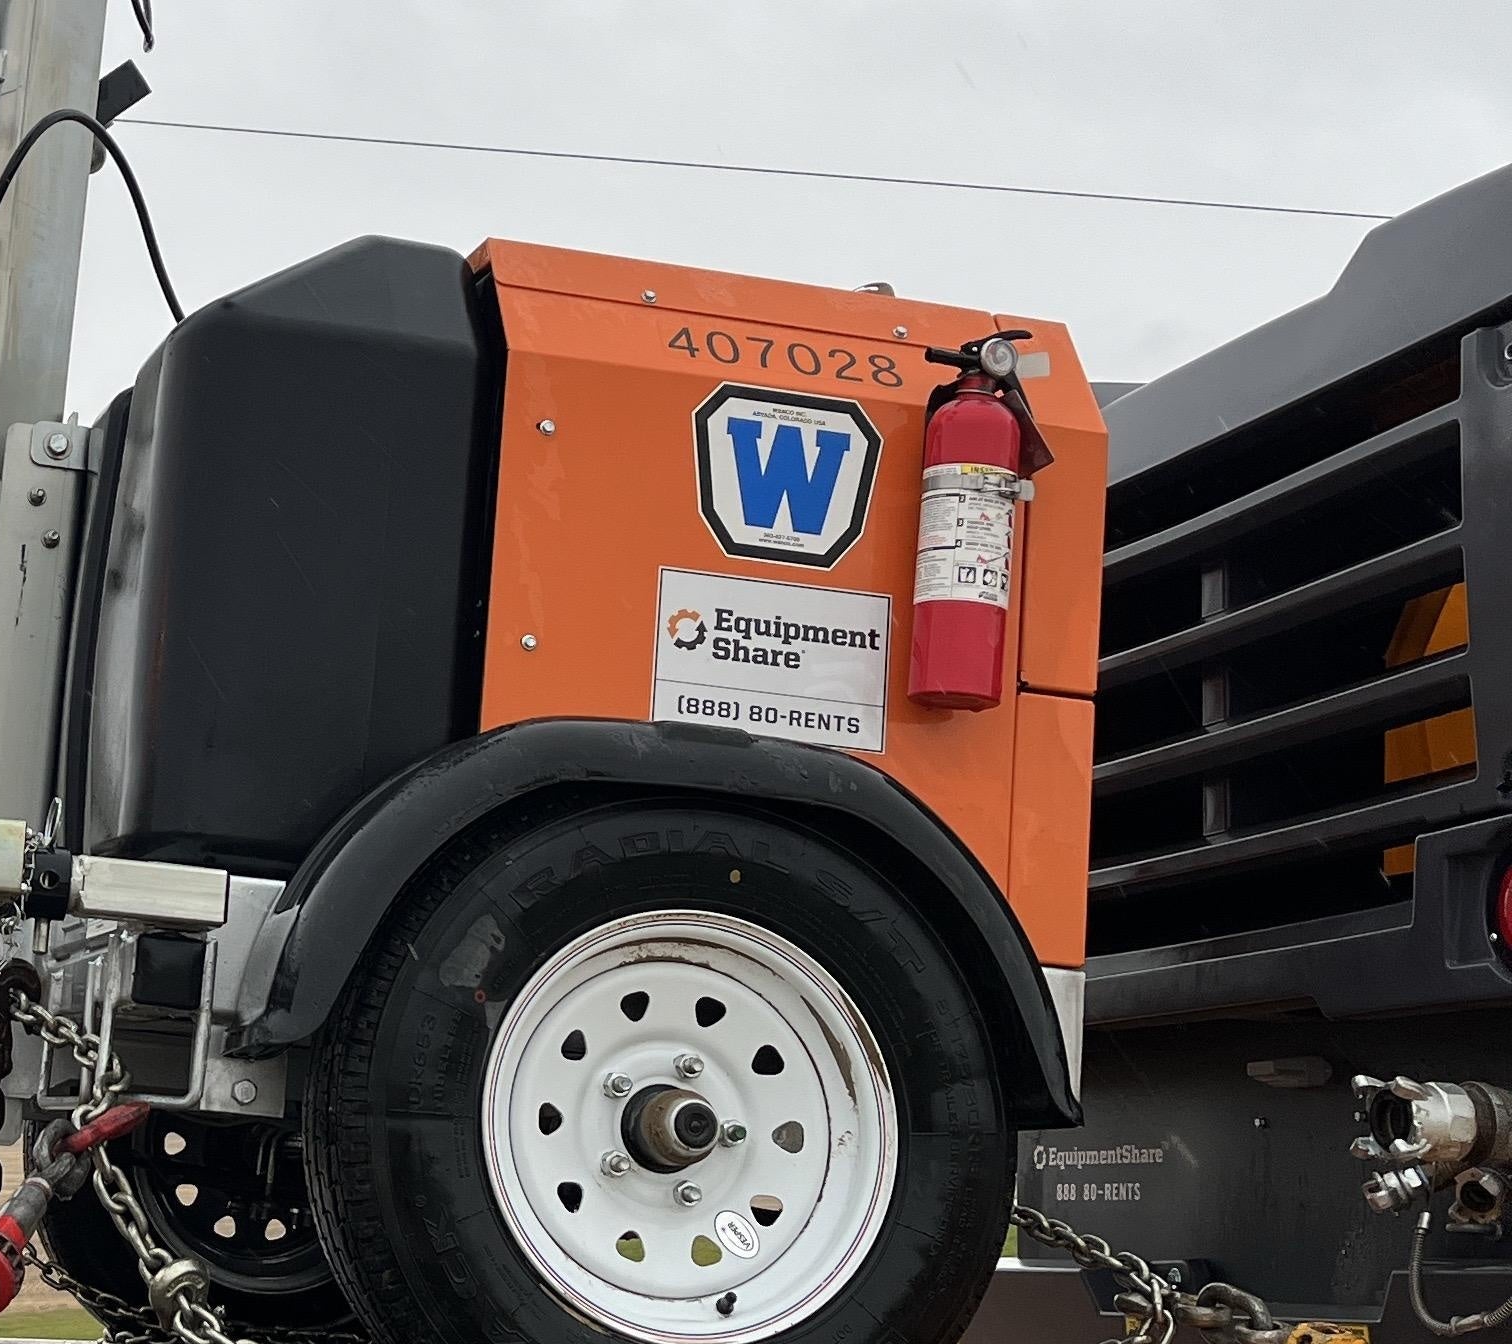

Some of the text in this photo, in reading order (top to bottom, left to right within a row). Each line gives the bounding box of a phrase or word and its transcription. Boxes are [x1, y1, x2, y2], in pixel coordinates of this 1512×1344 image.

[668, 327, 903, 388] 407028
[727, 417, 851, 536] W
[714, 608, 881, 651] Equipment
[712, 637, 801, 669] Share
[677, 695, 860, 734] (888) 80-RENTS
[1048, 1145, 1164, 1167] EquipmentShare
[1056, 1182, 1141, 1202] 888 80-RENTS
[727, 1220, 752, 1250] VESPER
